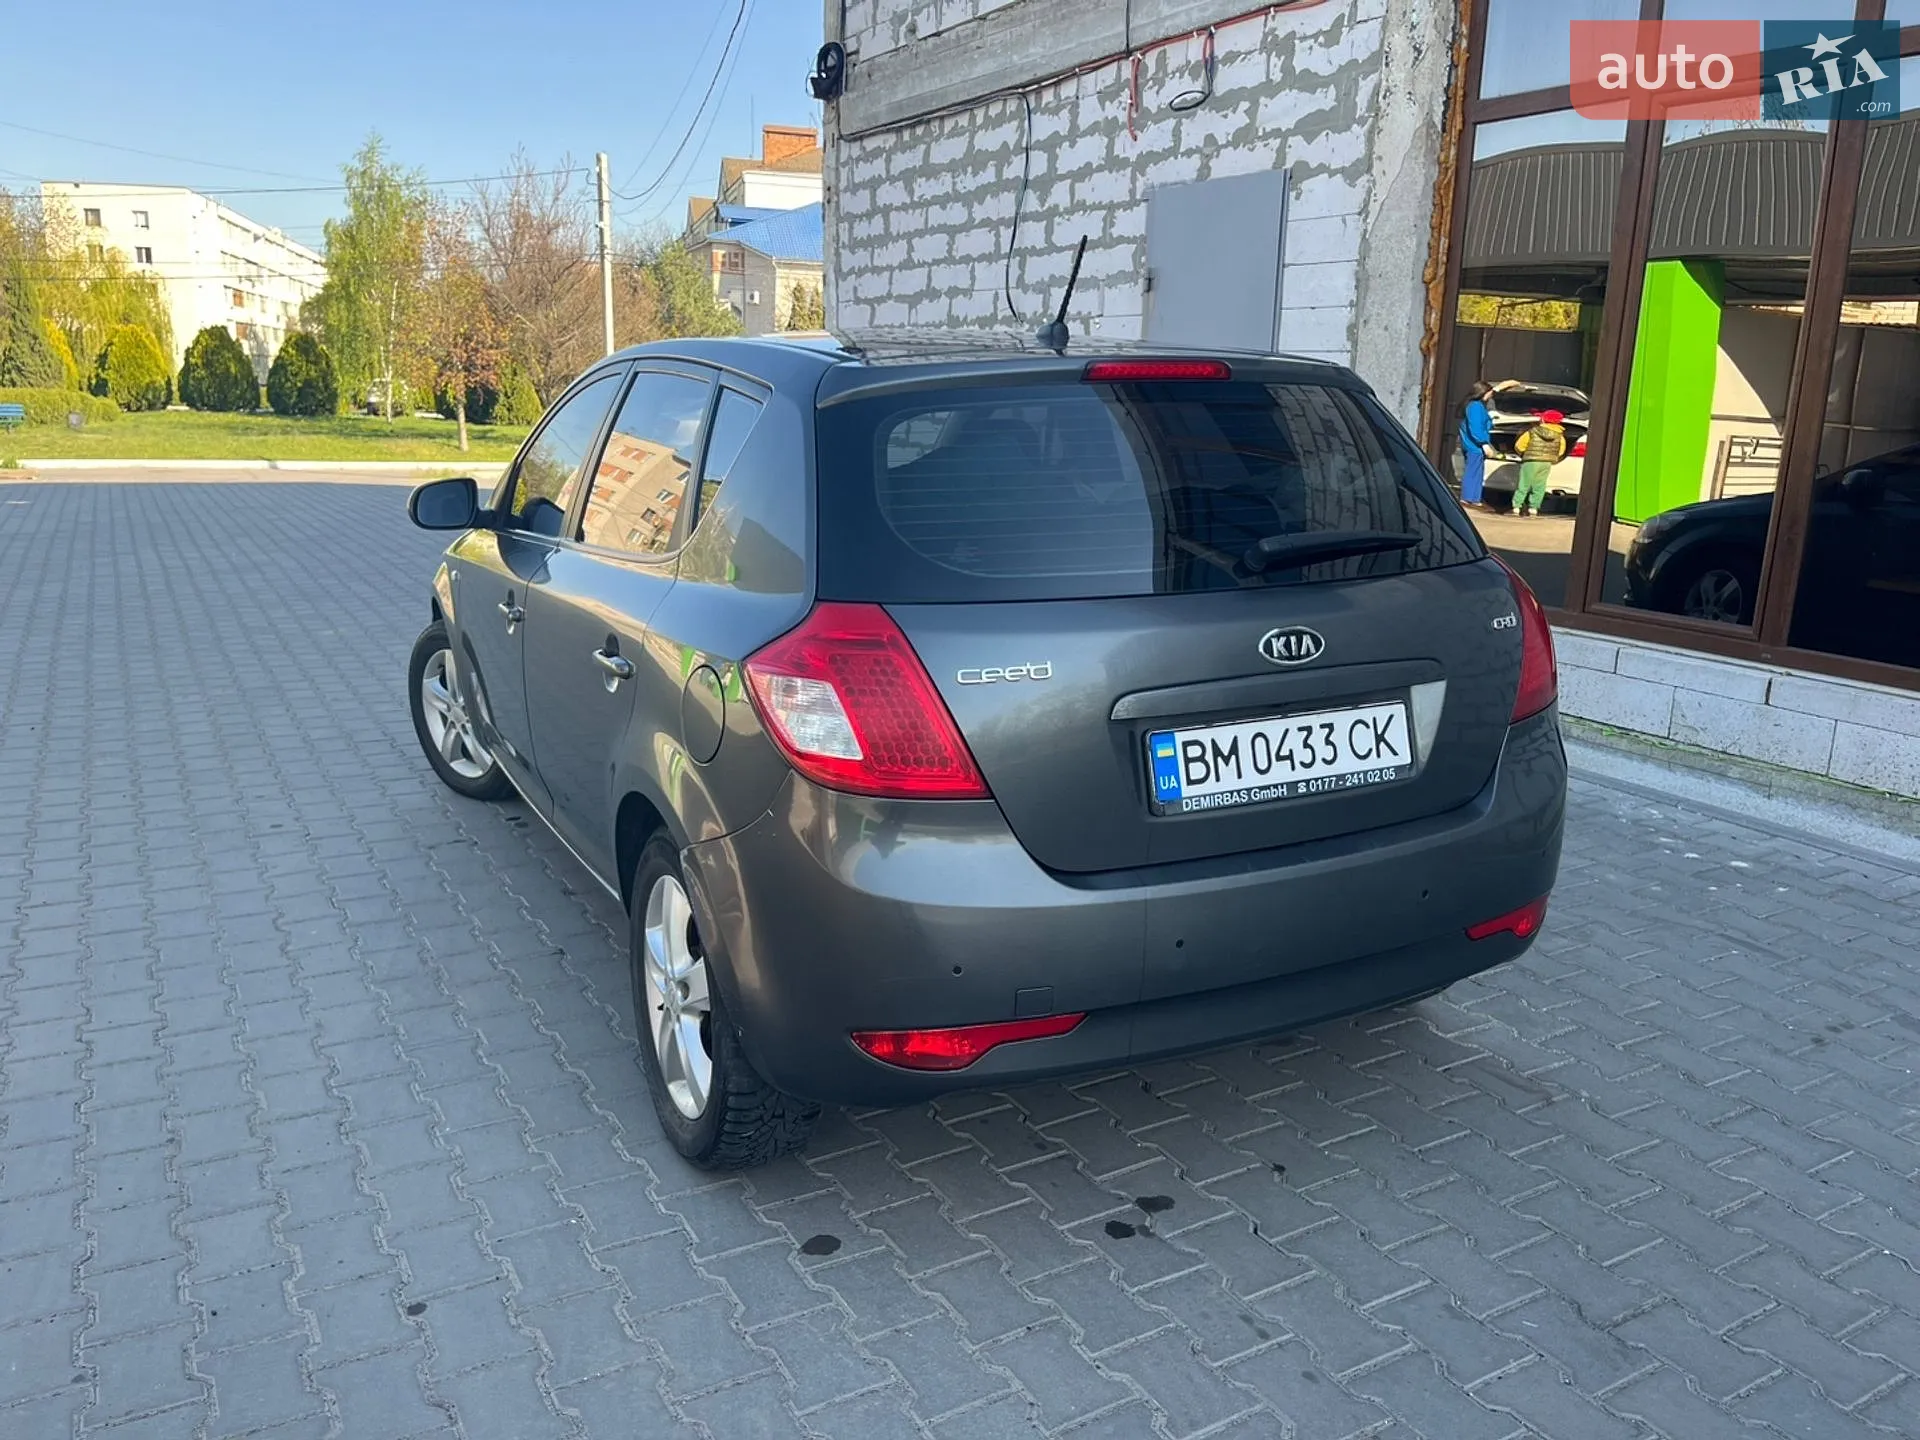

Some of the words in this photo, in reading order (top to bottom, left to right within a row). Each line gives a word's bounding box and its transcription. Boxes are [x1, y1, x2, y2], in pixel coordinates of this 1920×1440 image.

[1270, 634, 1316, 657] KIA
[1181, 735, 1242, 786] BM
[1250, 722, 1338, 775] 0433
[1349, 714, 1399, 760] CK
[1160, 776, 1178, 790] UA
[1182, 791, 1248, 812] DEMIRBAS
[1251, 784, 1287, 801] GmbH
[1309, 777, 1336, 792] 0177
[1345, 772, 1365, 787] 241
[1367, 770, 1380, 784] 02
[1382, 768, 1396, 780] 05
